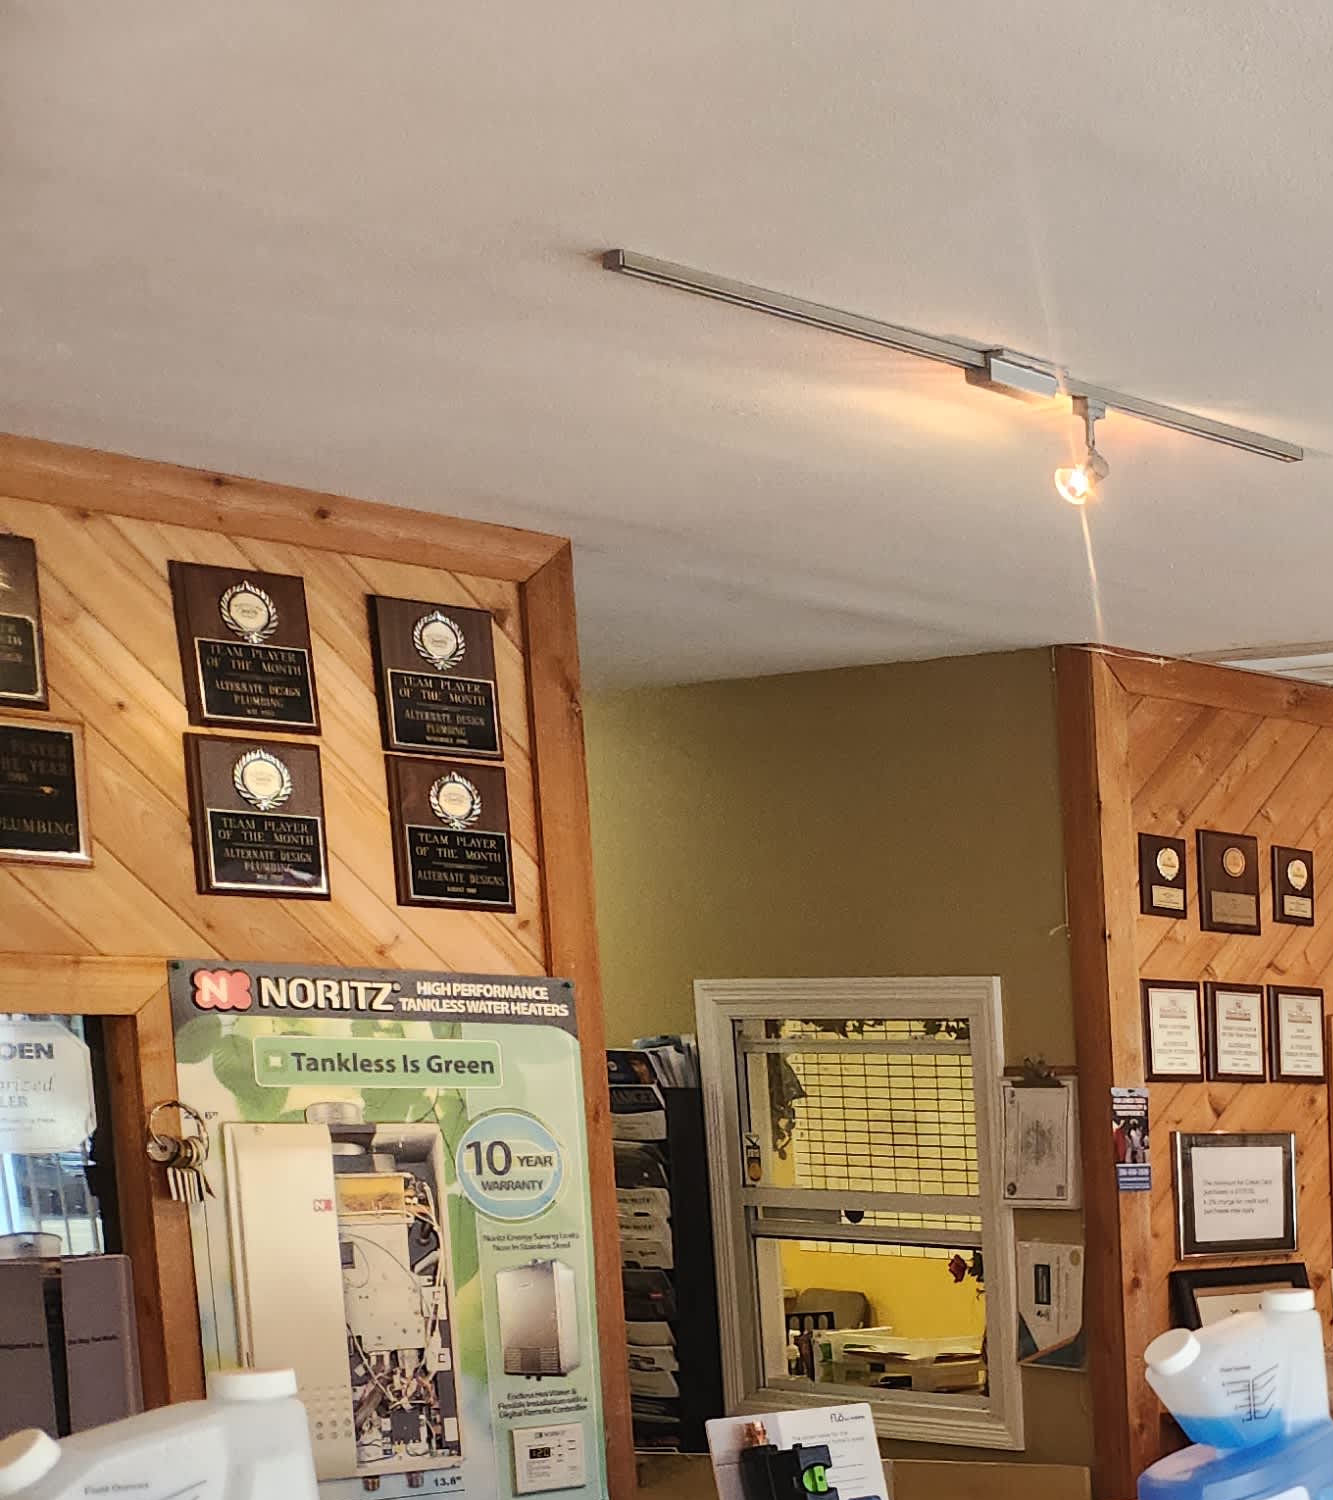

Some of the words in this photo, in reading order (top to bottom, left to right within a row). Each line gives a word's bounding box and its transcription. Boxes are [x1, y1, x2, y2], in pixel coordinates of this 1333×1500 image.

[209, 643, 245, 657] TEAM
[251, 647, 297, 663] PLAYER
[206, 656, 221, 668] OF
[231, 659, 252, 672] THE
[262, 662, 301, 676] MONTH
[403, 675, 433, 689] TEAM
[440, 679, 481, 694] PLAYER
[399, 688, 413, 698] OF
[421, 690, 441, 701] THE
[449, 693, 486, 706] MONTH
[222, 817, 256, 831] TEAM
[264, 820, 309, 834] PLAYER
[218, 829, 232, 840] OF
[242, 831, 265, 842] THE
[273, 834, 314, 846] MONTH
[418, 833, 449, 845] TEAM
[456, 836, 497, 849] PLAYER
[415, 847, 429, 857] OF
[437, 848, 459, 859] THE
[465, 850, 502, 863] MONTH
[259, 976, 395, 1011] NORITZ
[416, 981, 452, 997] HIGH
[453, 983, 549, 1001] PERFORMANCE
[399, 997, 466, 1014] TANKLESS
[466, 1000, 510, 1015] WATER
[510, 1001, 569, 1017] HEATERS
[291, 1052, 396, 1073] Tankless
[402, 1054, 420, 1074] Is
[426, 1055, 495, 1075] Green
[465, 1140, 512, 1176] 10
[516, 1155, 553, 1167] YEAR
[481, 1180, 544, 1191] WARRANTY
